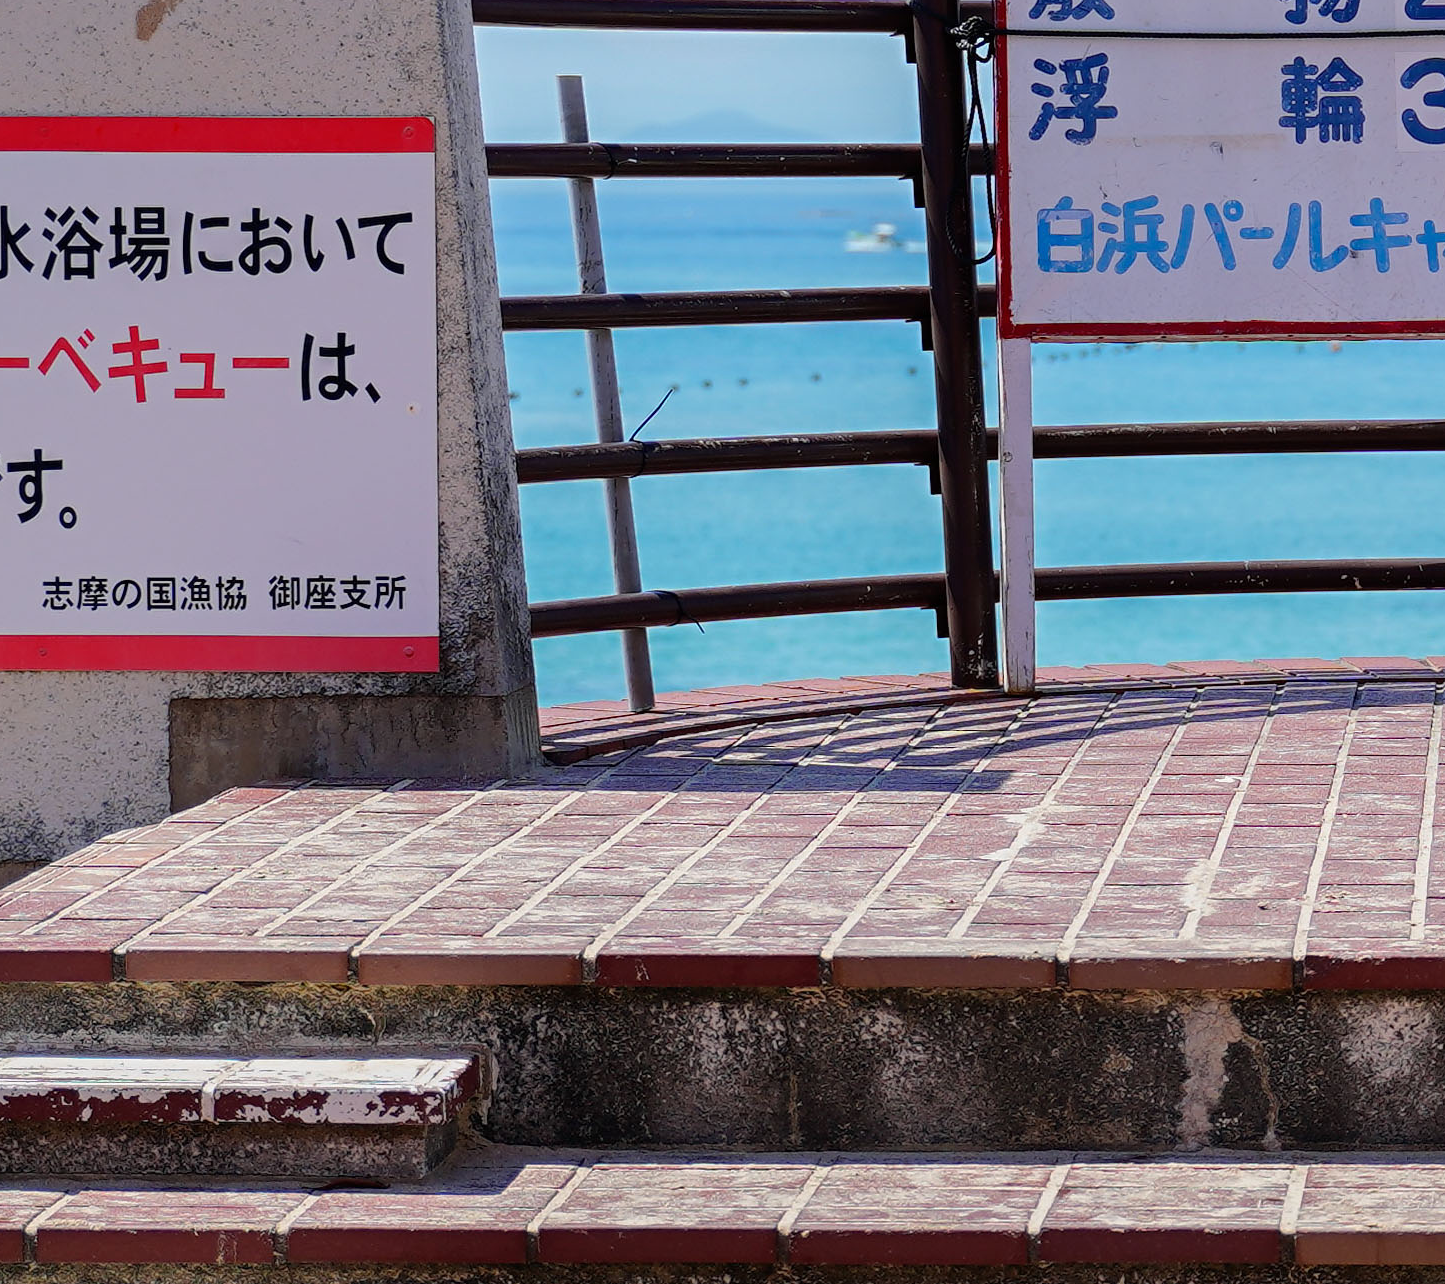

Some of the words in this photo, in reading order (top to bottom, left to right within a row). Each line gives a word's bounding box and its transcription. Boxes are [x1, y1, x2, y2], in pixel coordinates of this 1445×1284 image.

[1028, 51, 1118, 145] 浮
[1277, 56, 1366, 144] 輪
[41, 575, 248, 612] 志摩の国漁協
[268, 574, 408, 612] 御座支所
